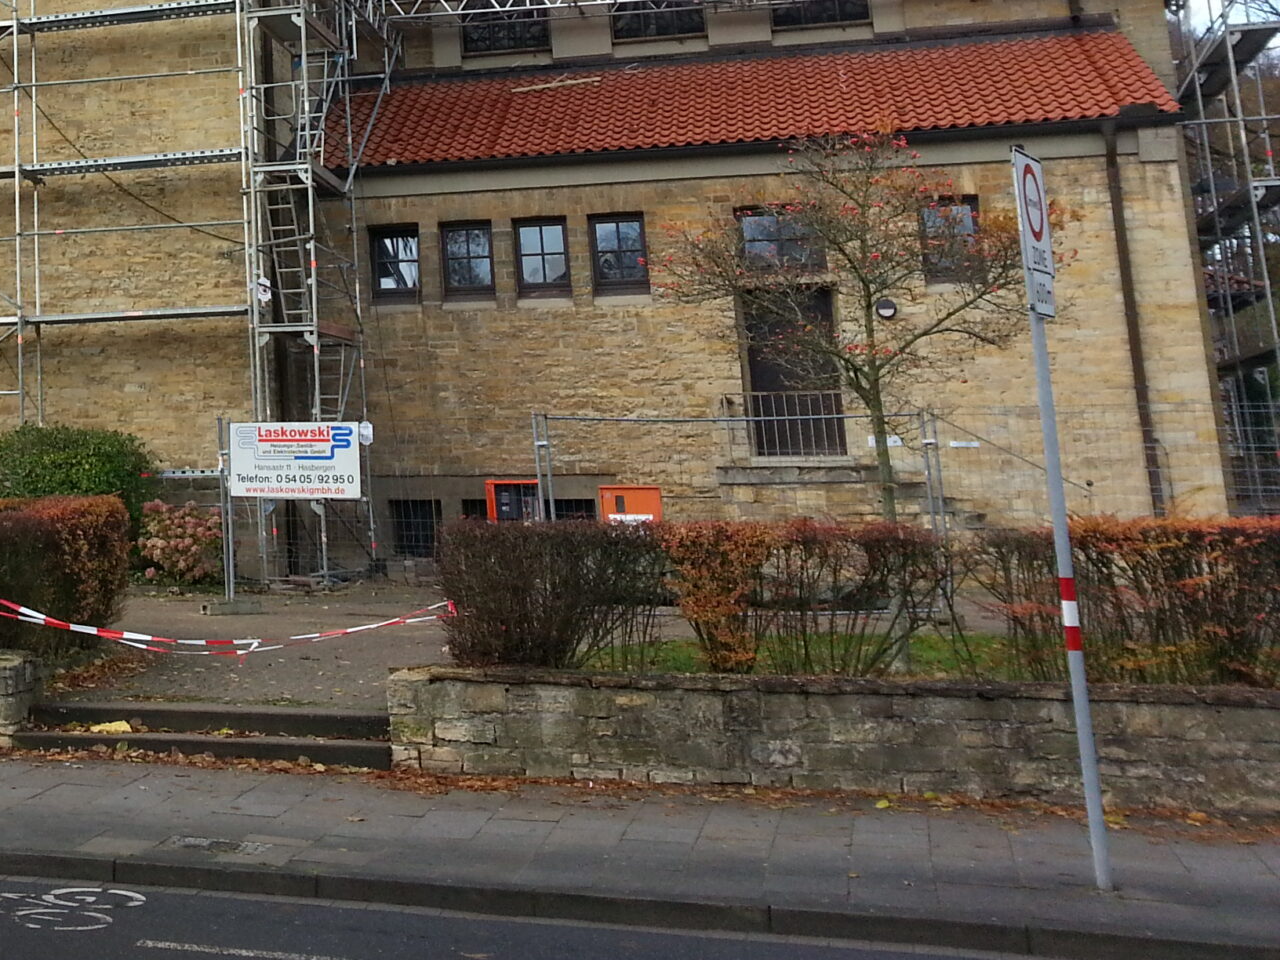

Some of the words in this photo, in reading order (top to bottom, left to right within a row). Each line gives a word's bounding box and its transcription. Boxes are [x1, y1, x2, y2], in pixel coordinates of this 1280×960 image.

[258, 426, 330, 438] Laskowski
[298, 464, 336, 473] Hasbergen
[236, 473, 272, 484] Telefon:
[276, 474, 283, 483] 0
[284, 474, 297, 483] 54
[245, 485, 346, 496] www.laskowskigmbh.de
